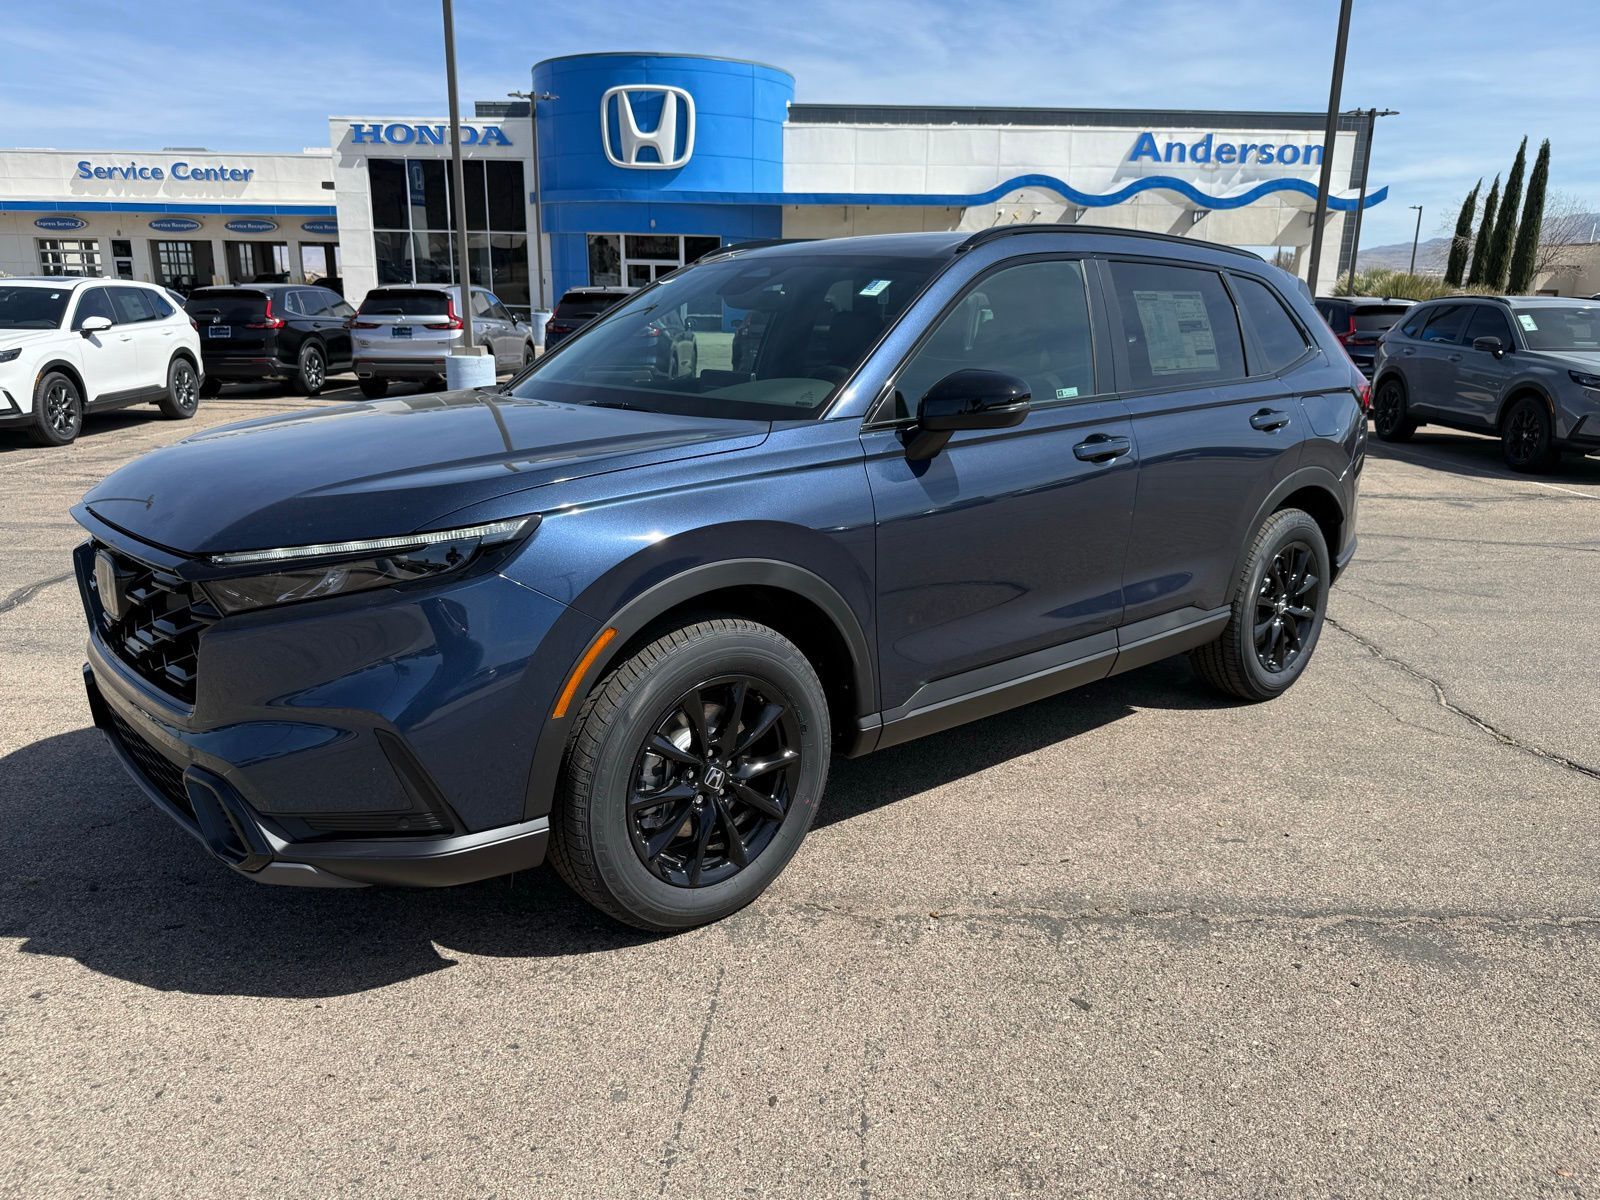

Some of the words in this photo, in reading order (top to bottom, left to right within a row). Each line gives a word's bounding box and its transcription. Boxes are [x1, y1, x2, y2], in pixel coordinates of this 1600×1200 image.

[350, 123, 513, 146] HONDA
[1128, 131, 1325, 165] Anderson
[77, 160, 165, 181] Service
[170, 161, 254, 182] Center
